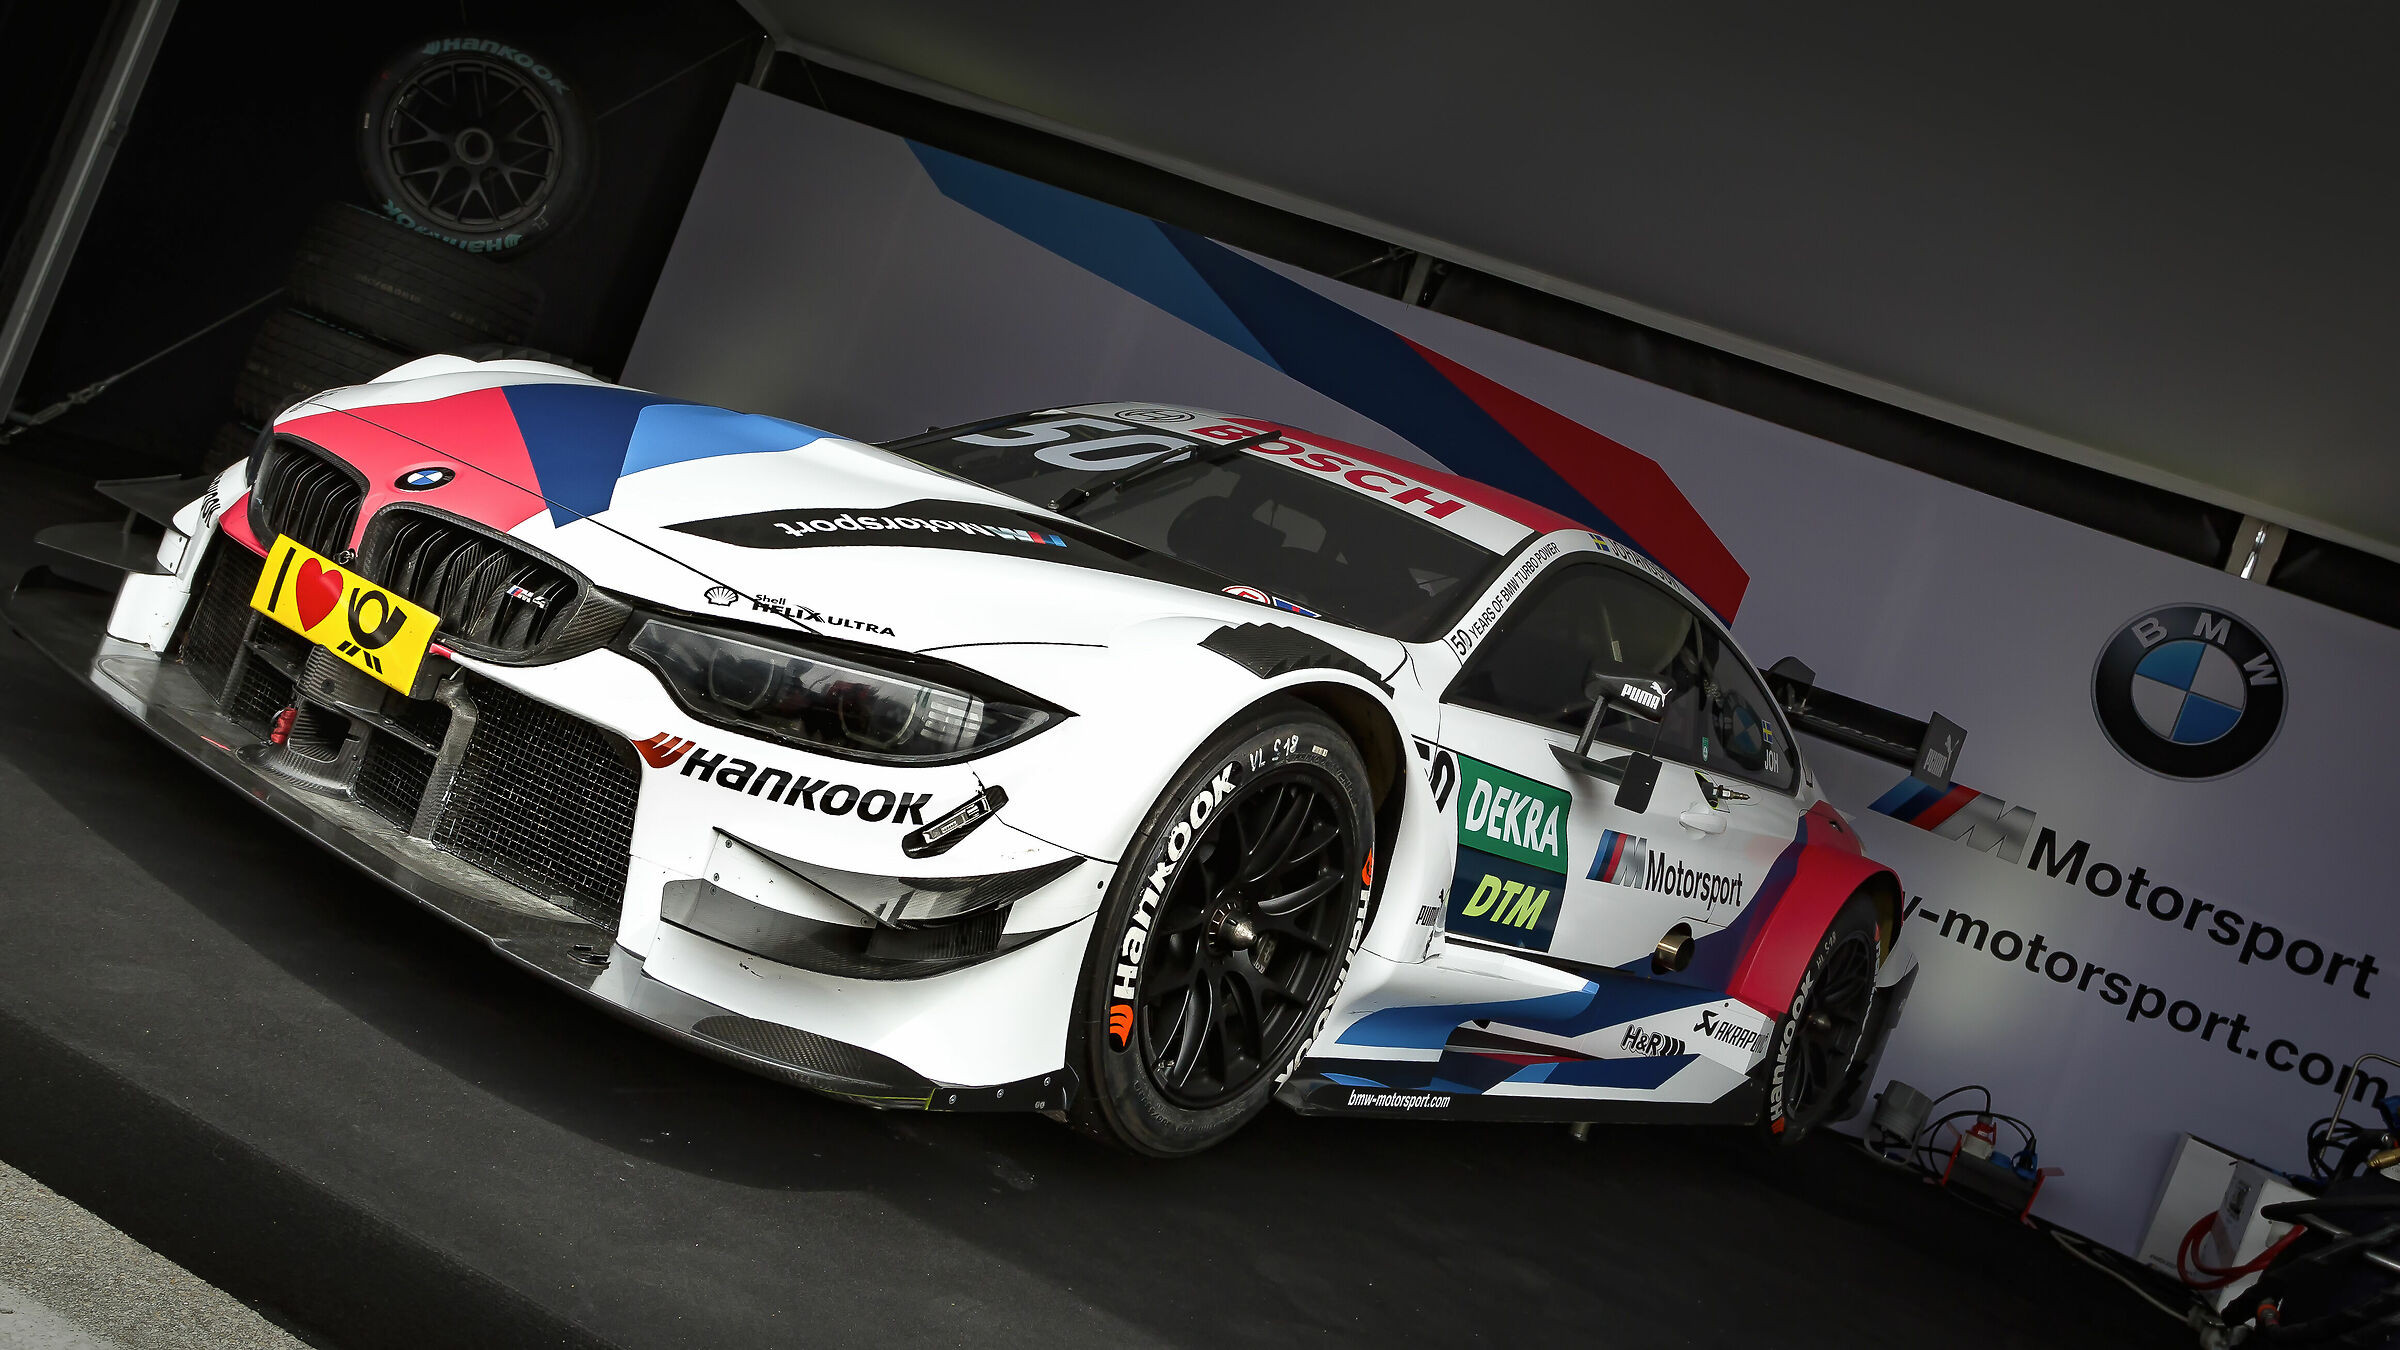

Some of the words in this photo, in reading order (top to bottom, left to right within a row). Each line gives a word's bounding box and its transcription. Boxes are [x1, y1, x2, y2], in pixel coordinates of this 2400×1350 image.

[951, 417, 1199, 472] 50
[1188, 425, 1467, 520] BOSCH
[773, 513, 996, 538] Motorsport
[267, 546, 297, 614] I
[756, 594, 787, 606] Shell
[1450, 629, 1473, 656] 50
[1468, 607, 1496, 639] YEARS
[1491, 594, 1504, 613] OF
[1500, 577, 1520, 602] BMW
[1514, 557, 1540, 584] TURBO
[1533, 541, 1561, 565] POWER
[752, 603, 825, 624] HELIX
[827, 616, 896, 638] ULTRA
[2131, 612, 2278, 687] BMW
[1620, 683, 1662, 711] PUMA
[1414, 740, 1456, 814] 0
[1764, 749, 1779, 774] JOH
[1465, 777, 1559, 857] DEKRA
[1461, 873, 1551, 931] DTM
[1645, 849, 1743, 911] Motorsport
[2027, 827, 2379, 999] Motorsport
[1621, 1024, 1665, 1058] H&R
[1347, 1089, 1451, 1111] bmw-motorsport.com
